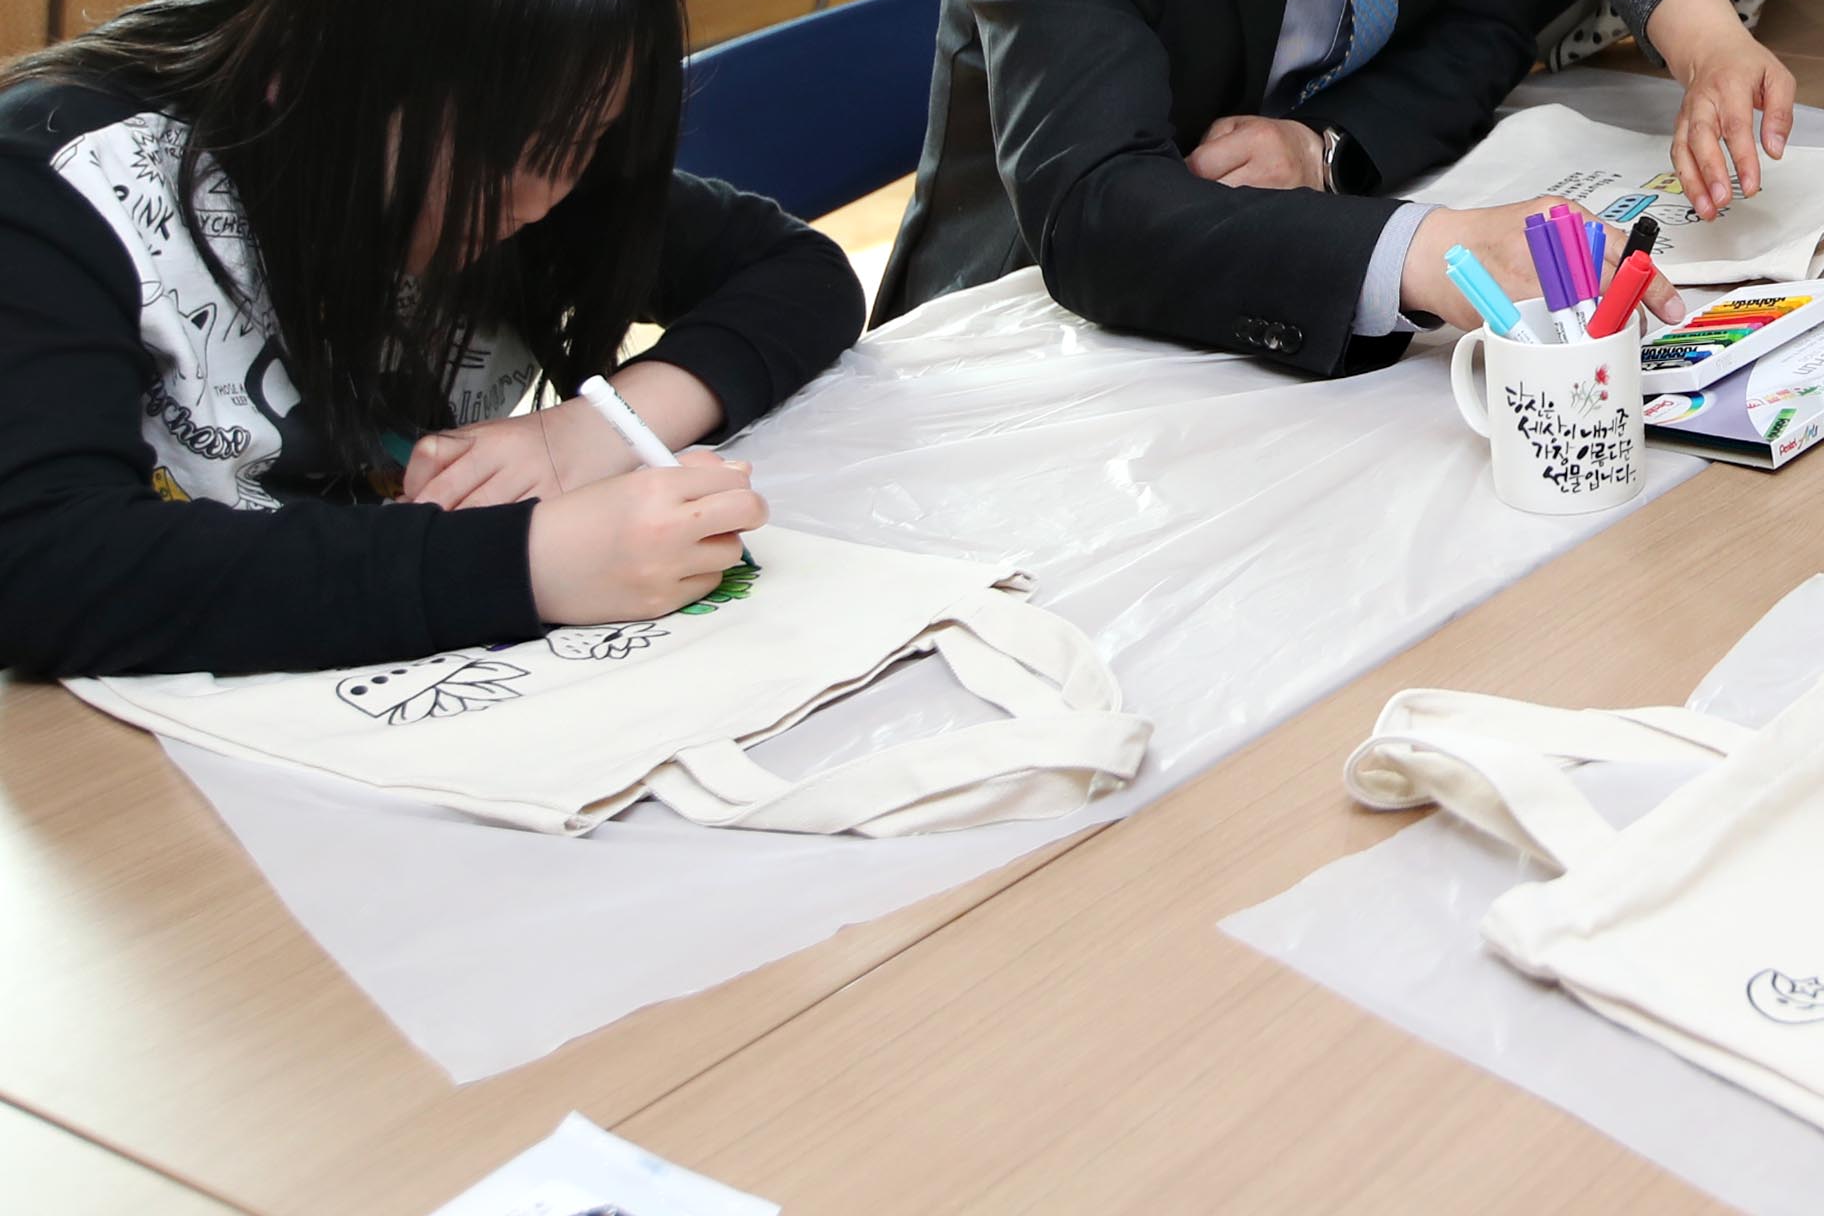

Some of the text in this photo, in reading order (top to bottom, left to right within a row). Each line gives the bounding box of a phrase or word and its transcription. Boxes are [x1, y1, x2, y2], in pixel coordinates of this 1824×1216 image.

[1505, 381, 1555, 419] 당신은
[1532, 439, 1633, 467] 가장 아름다운
